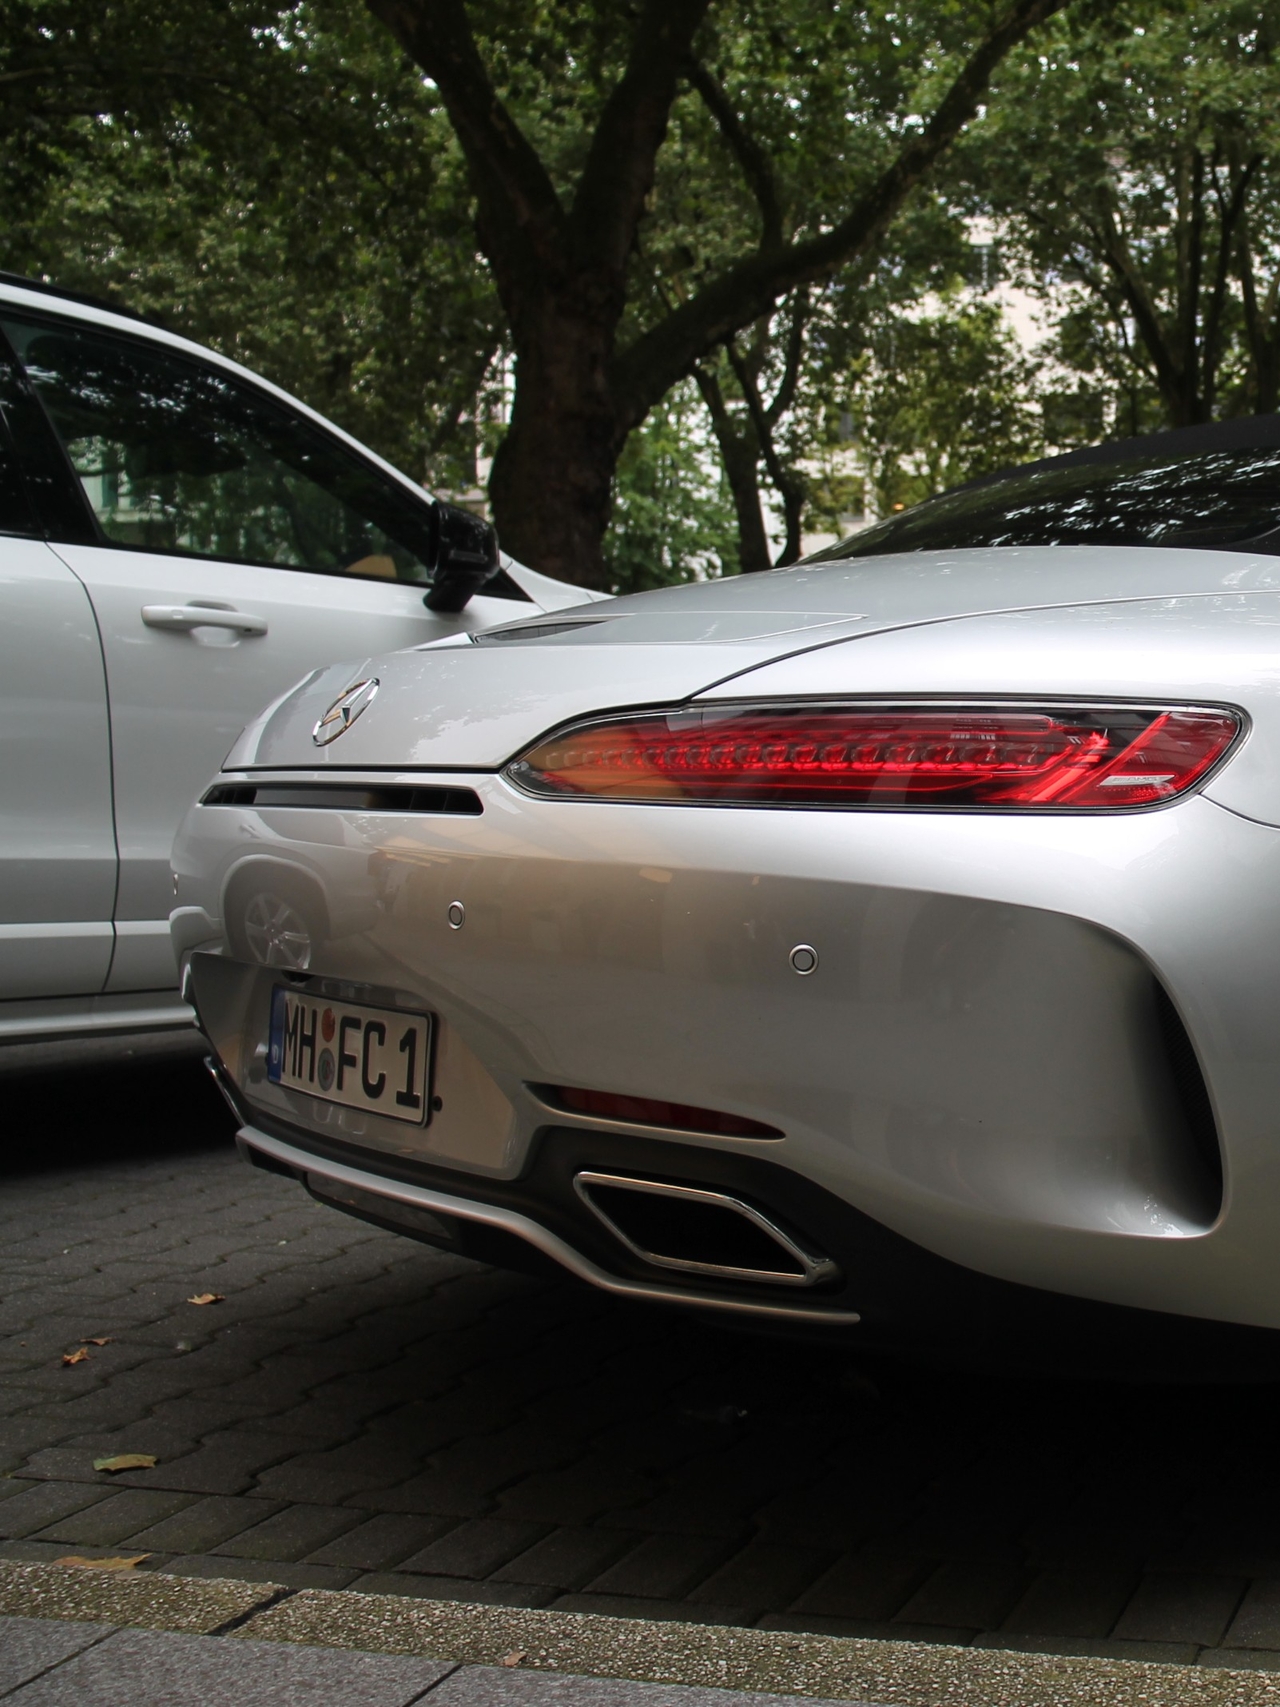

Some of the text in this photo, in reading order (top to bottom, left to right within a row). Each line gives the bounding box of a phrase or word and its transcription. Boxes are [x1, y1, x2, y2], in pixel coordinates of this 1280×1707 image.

[281, 1000, 421, 1109] MH FC 1
